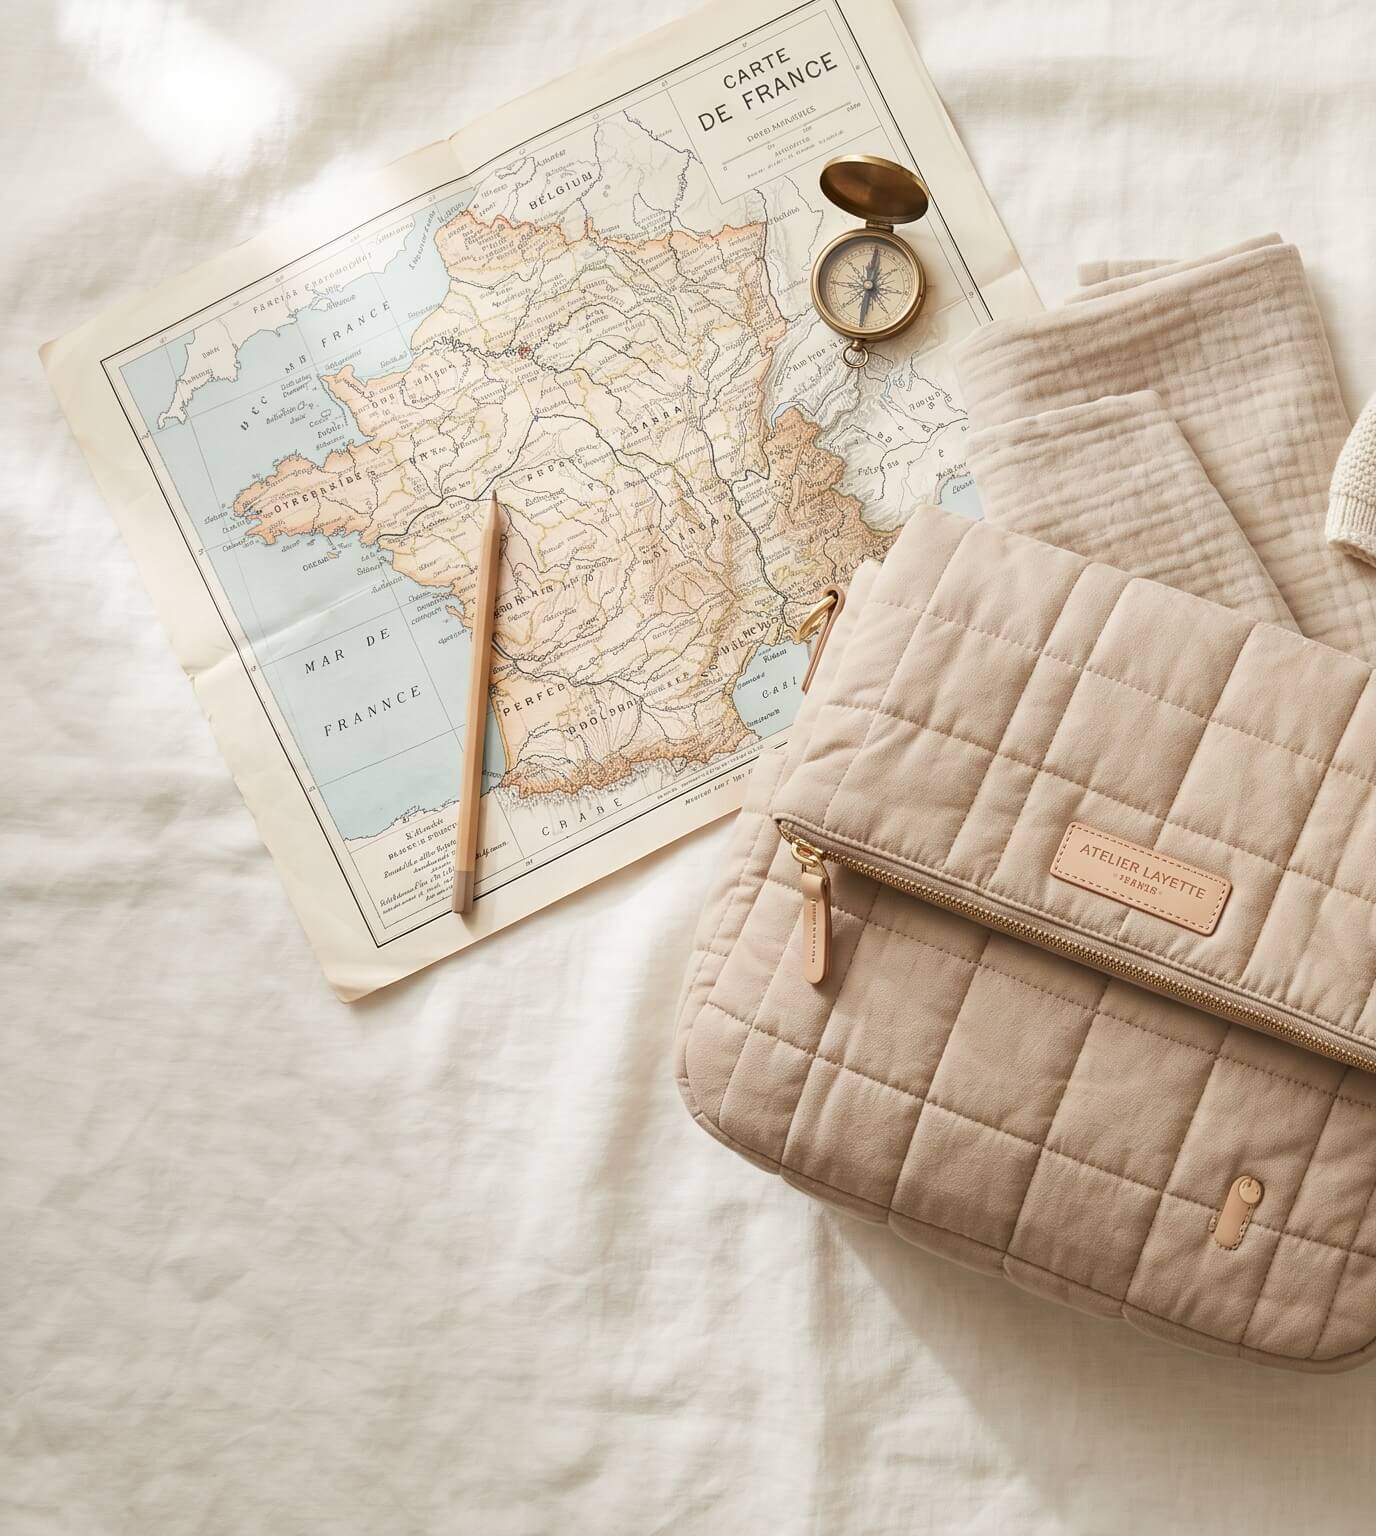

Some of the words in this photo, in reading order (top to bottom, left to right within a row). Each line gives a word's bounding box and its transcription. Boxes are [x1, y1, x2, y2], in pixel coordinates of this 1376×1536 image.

[698, 103, 733, 132] DE
[741, 51, 838, 110] FRANCE
[723, 47, 791, 89] CARTE
[321, 300, 391, 349] FRANCE
[304, 649, 345, 674] MAR
[366, 628, 391, 647] DE
[323, 685, 421, 737] FRANNCE
[1080, 843, 1140, 874] ATELIER
[1142, 866, 1207, 900] LAYETTE
